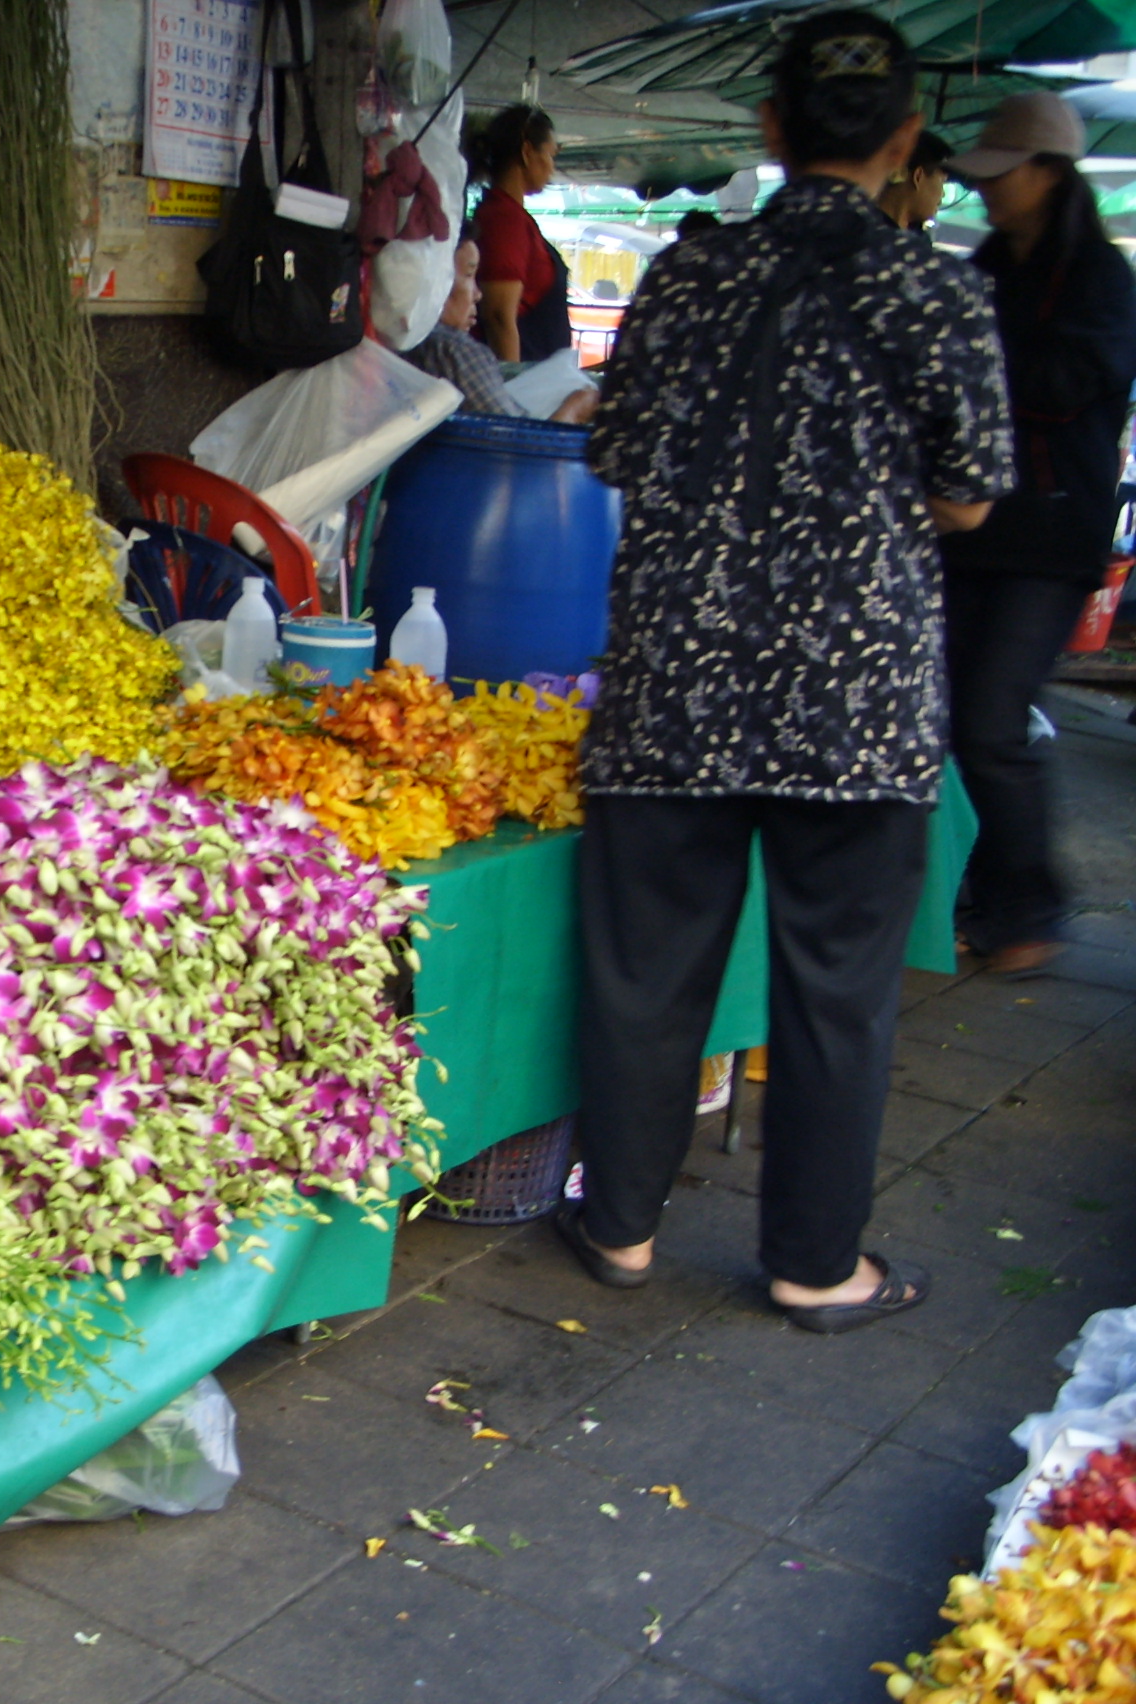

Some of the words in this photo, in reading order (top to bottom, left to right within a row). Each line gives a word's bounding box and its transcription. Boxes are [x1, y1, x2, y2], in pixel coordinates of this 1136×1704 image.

[207, 0, 215, 17] 2
[222, 0, 230, 19] 3
[239, 5, 248, 22] 4
[160, 15, 168, 32] 6
[179, 17, 186, 35] 7
[194, 20, 201, 39] 8
[207, 23, 215, 41] 9
[220, 27, 233, 46] 10
[158, 41, 172, 60] 13
[175, 43, 188, 62] 14
[192, 47, 203, 67] 15
[207, 51, 218, 70] 16
[219, 55, 231, 74] 17
[157, 68, 170, 87] 20
[174, 71, 186, 91] 21
[191, 74, 204, 94] 22
[206, 78, 217, 97] 23
[218, 81, 230, 100] 24
[157, 96, 169, 115] 27
[174, 98, 187, 118] 28
[191, 102, 204, 121] 29
[206, 105, 217, 124] 30
